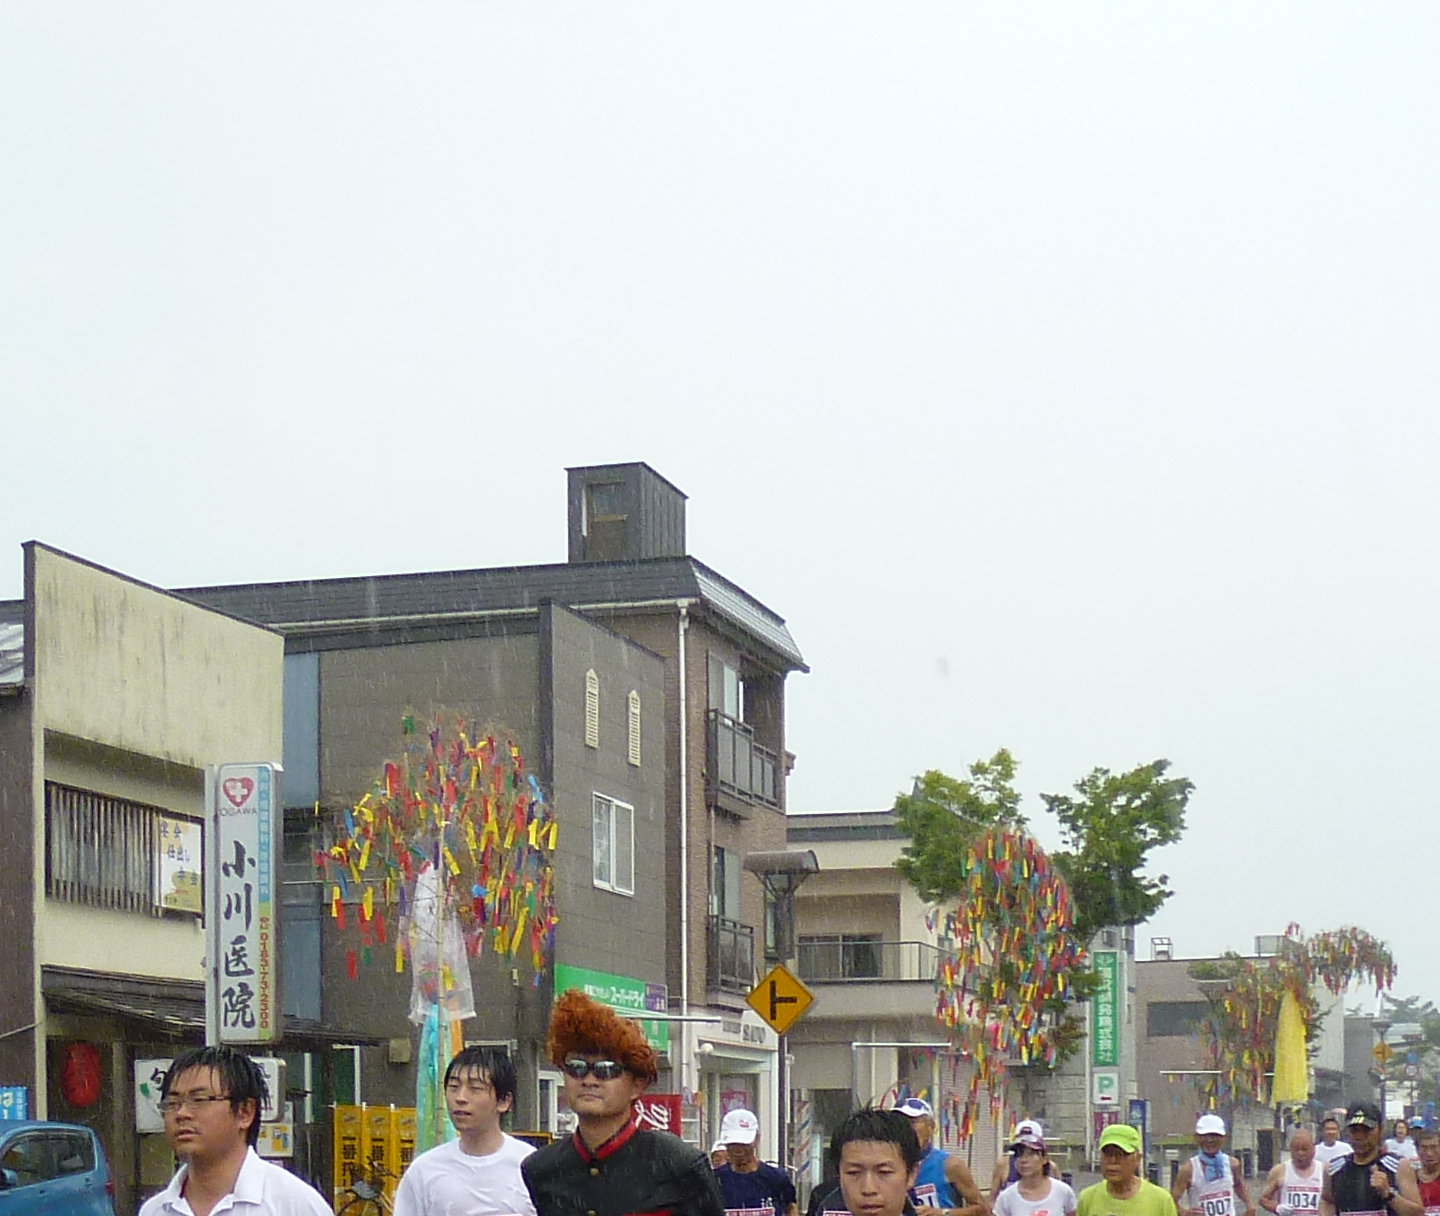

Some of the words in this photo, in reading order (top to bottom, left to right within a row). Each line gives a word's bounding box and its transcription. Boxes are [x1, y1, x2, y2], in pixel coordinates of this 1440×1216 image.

[220, 807, 257, 817] OGAWA
[221, 840, 257, 1029] 小川医院
[1098, 1075, 1114, 1094] P
[1288, 1192, 1317, 1208] 1034
